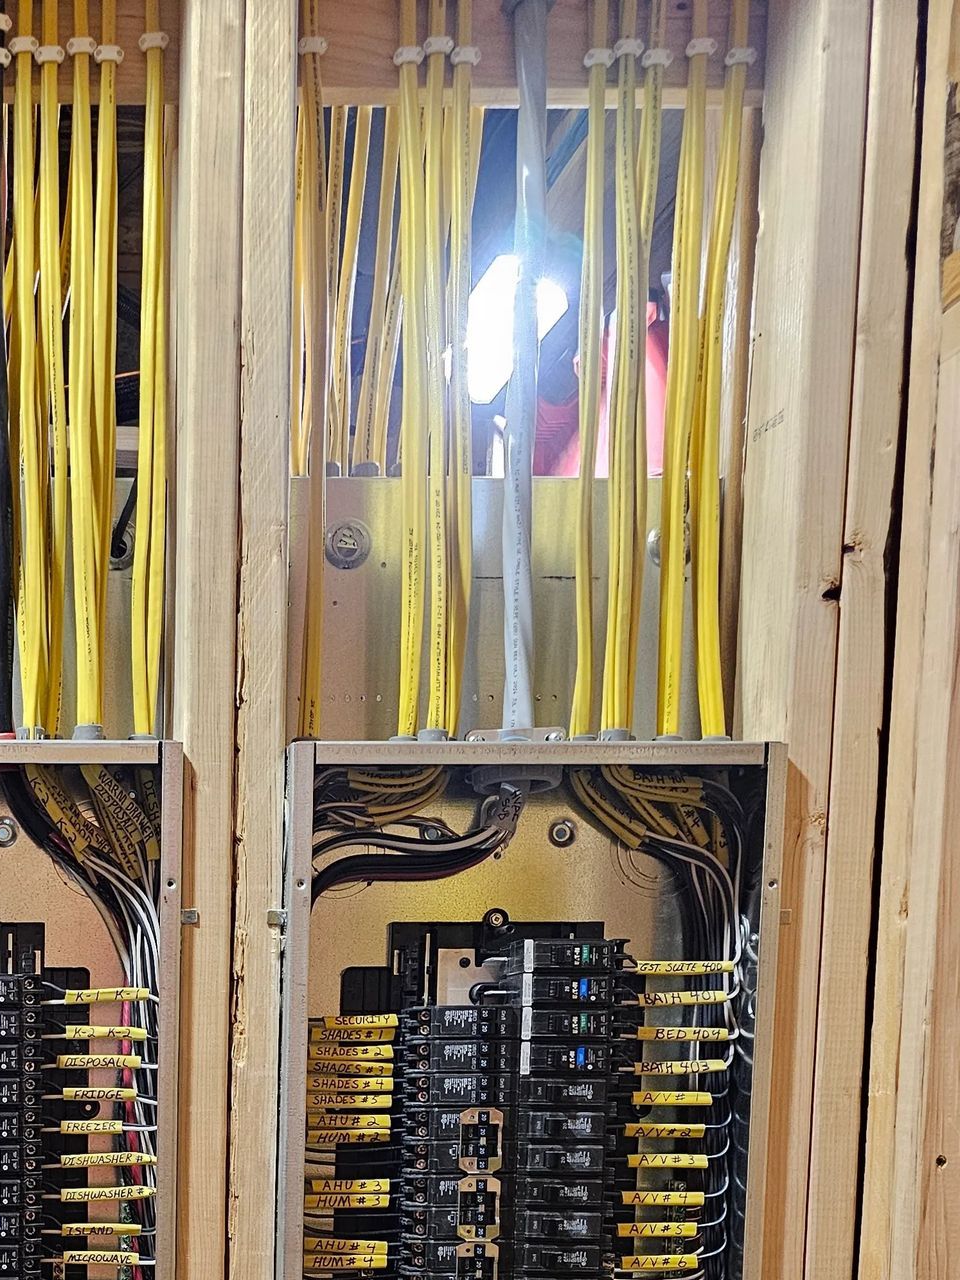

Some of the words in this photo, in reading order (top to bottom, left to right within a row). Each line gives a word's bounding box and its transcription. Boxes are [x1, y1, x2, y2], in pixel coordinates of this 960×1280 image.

[665, 962, 697, 971] SUITE
[702, 962, 723, 971] 400
[644, 993, 682, 1005] BATH
[690, 990, 717, 1001] 401
[335, 1016, 390, 1025] SECURITY
[655, 1028, 686, 1039] BED
[316, 1047, 359, 1057] SHADES
[64, 1057, 128, 1068] DISPOSALL
[313, 1062, 361, 1073] SHADES
[640, 1062, 673, 1074] BATH
[680, 1062, 709, 1073] 403
[313, 1079, 359, 1089] SHADES
[74, 1090, 123, 1100] FRIDGE
[313, 1095, 356, 1105] SHADES
[317, 1116, 348, 1125] AHU
[66, 1122, 116, 1131] FREEZER
[317, 1133, 350, 1143] HUM
[63, 1154, 132, 1166] DISHWASHER
[639, 1155, 667, 1165] A/V
[322, 1181, 353, 1191] AHU
[65, 1189, 133, 1201] DISHWASHER
[631, 1194, 659, 1203] A/V
[317, 1196, 351, 1207] HUM
[66, 1226, 114, 1236] ISLAND
[629, 1224, 657, 1234] A/V
[314, 1240, 346, 1250] AHU
[67, 1254, 132, 1264] MICROWAVE
[313, 1256, 344, 1267] HUM
